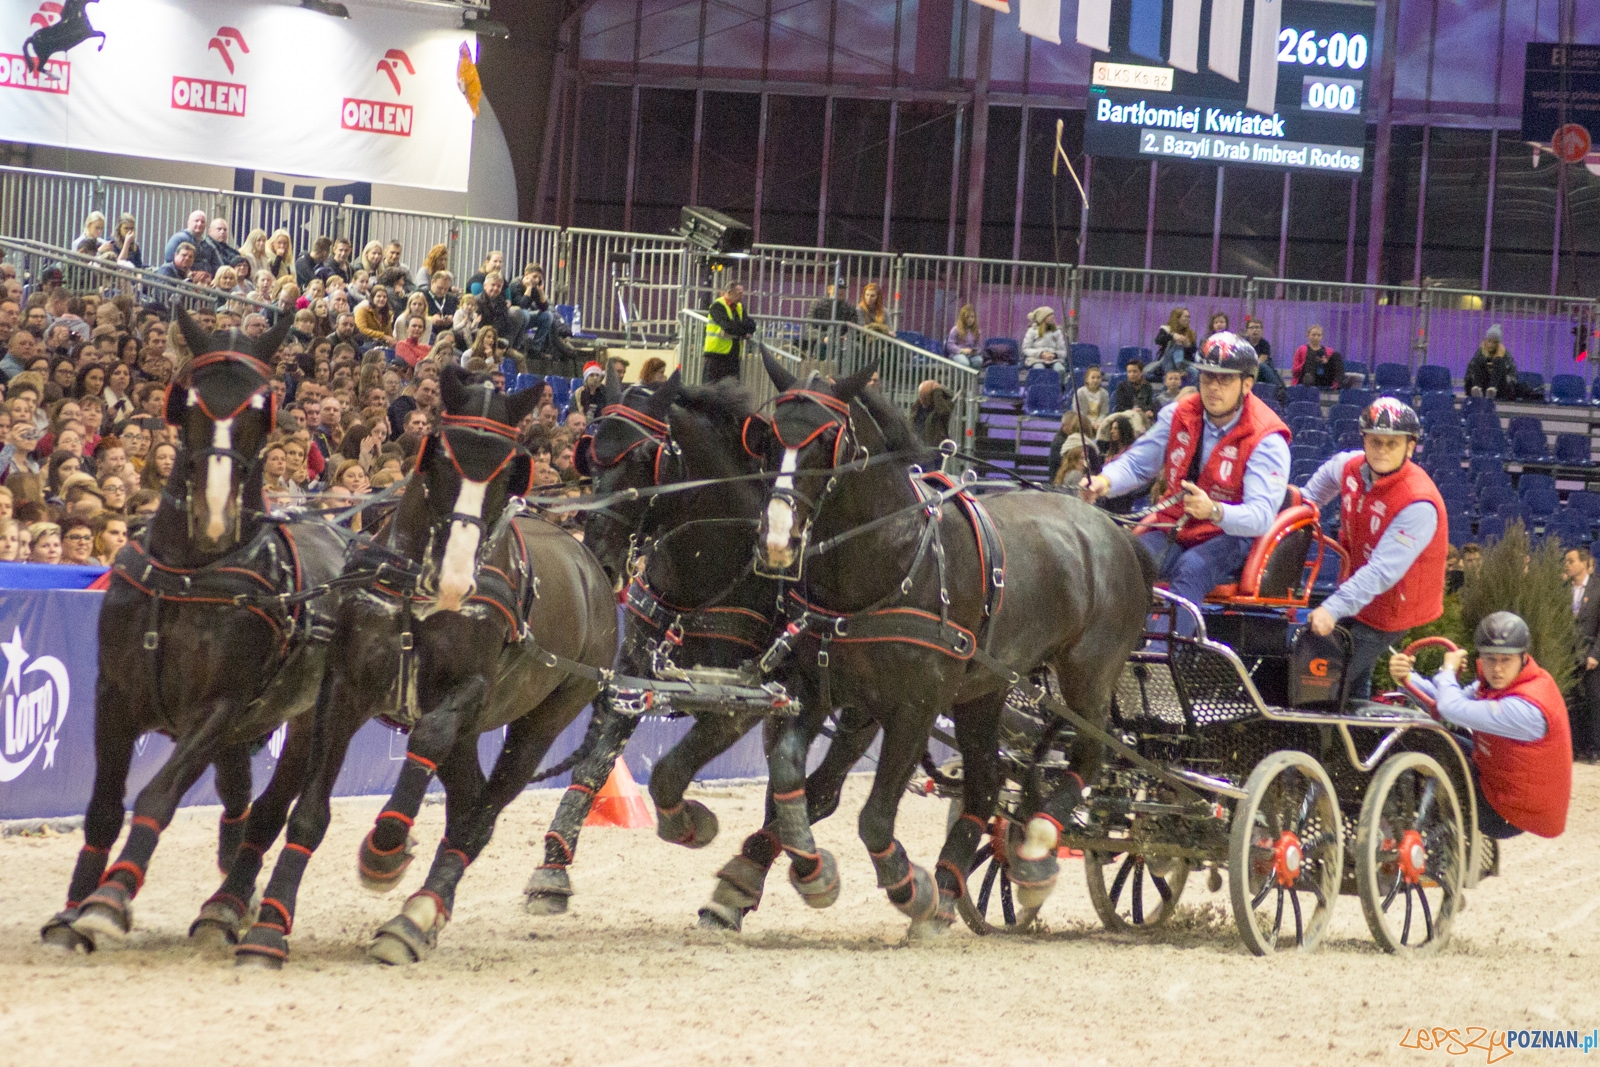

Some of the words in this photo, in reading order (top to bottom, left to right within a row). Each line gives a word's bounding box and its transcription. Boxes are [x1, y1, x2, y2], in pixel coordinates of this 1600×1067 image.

[1276, 27, 1368, 70] 26:00
[0, 56, 68, 91] ORLEN
[1098, 66, 1130, 83] SLKS
[173, 80, 245, 114] ORLEN
[1308, 82, 1356, 111] 000
[343, 101, 411, 134] ORLEN
[1097, 98, 1200, 133] Bartłomiej
[1205, 108, 1286, 138] Kwiatek
[1144, 133, 1159, 152] 2.
[1163, 135, 1210, 159] Bazyli
[1213, 139, 1249, 161] Drab
[1253, 142, 1307, 166] Imbred
[1310, 147, 1360, 170] Rodos
[5, 679, 53, 755] LOTTO
